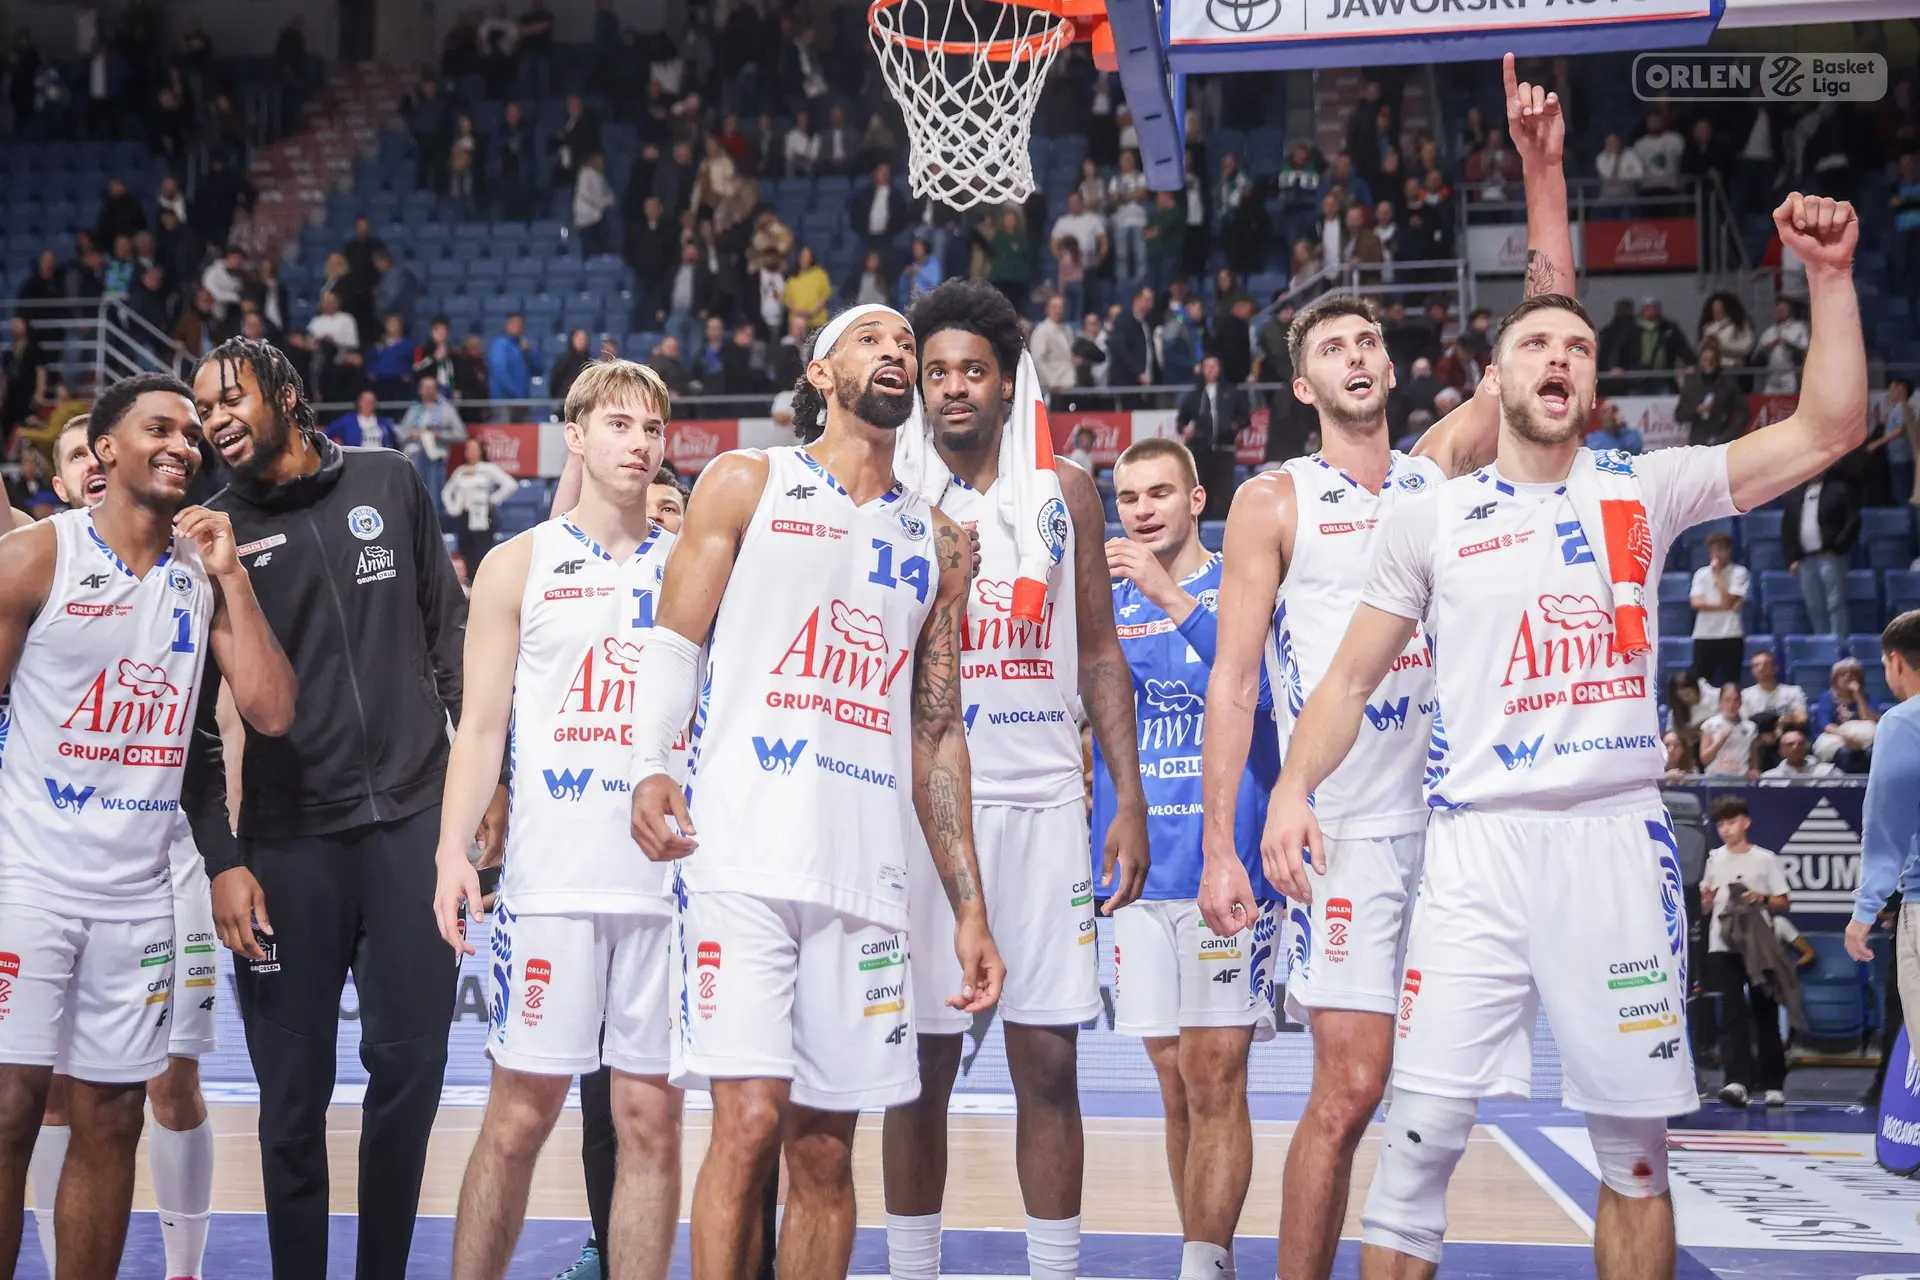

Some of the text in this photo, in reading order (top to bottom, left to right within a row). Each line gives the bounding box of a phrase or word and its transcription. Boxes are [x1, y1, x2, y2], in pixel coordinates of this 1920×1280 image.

[786, 484, 818, 499] 4F
[1320, 489, 1345, 503] 4F
[1464, 501, 1498, 520] 4F
[774, 521, 810, 533] ORLEN
[828, 527, 849, 536] Basket
[1322, 524, 1350, 533] ORLEN
[1461, 540, 1497, 555] ORLEN
[253, 552, 273, 568] 4F
[355, 549, 394, 575] Anwil
[553, 559, 585, 574] 4F
[868, 538, 931, 604] 14
[79, 573, 110, 588] 4F
[357, 575, 377, 584] GRUPA
[546, 589, 579, 598] ORLEN
[69, 605, 103, 615] ORLEN
[171, 607, 195, 653] 1
[1117, 627, 1145, 636] ORLEN
[1391, 654, 1423, 672] UPA
[961, 663, 998, 680] UPA
[60, 668, 193, 736] Anwil
[1504, 678, 1643, 715] GRUPA ORLEN
[766, 691, 892, 732] GRUPA ORLE
[553, 727, 617, 743] GRUPA
[1554, 735, 1657, 756] WŁOCŁAWEK
[58, 742, 182, 766] GRUPA ORLEN
[815, 753, 897, 790] WŁOCŁAWE
[1148, 804, 1204, 816] WŁOCŁAW
[1327, 905, 1351, 913] ORLEN
[861, 935, 900, 955] canvil
[1200, 937, 1237, 949] canvil
[698, 951, 720, 959] ORLEN
[1325, 948, 1349, 956] Basket
[1329, 955, 1344, 963] Liga
[527, 966, 550, 976] ORLEN
[1609, 954, 1660, 975] canvil
[1212, 968, 1241, 983] 4F
[1619, 997, 1670, 1018] canvil
[521, 1011, 543, 1020] Basket
[524, 1018, 538, 1028] Liga
[885, 1023, 909, 1045] 4F
[1648, 1037, 1681, 1060] 4F
